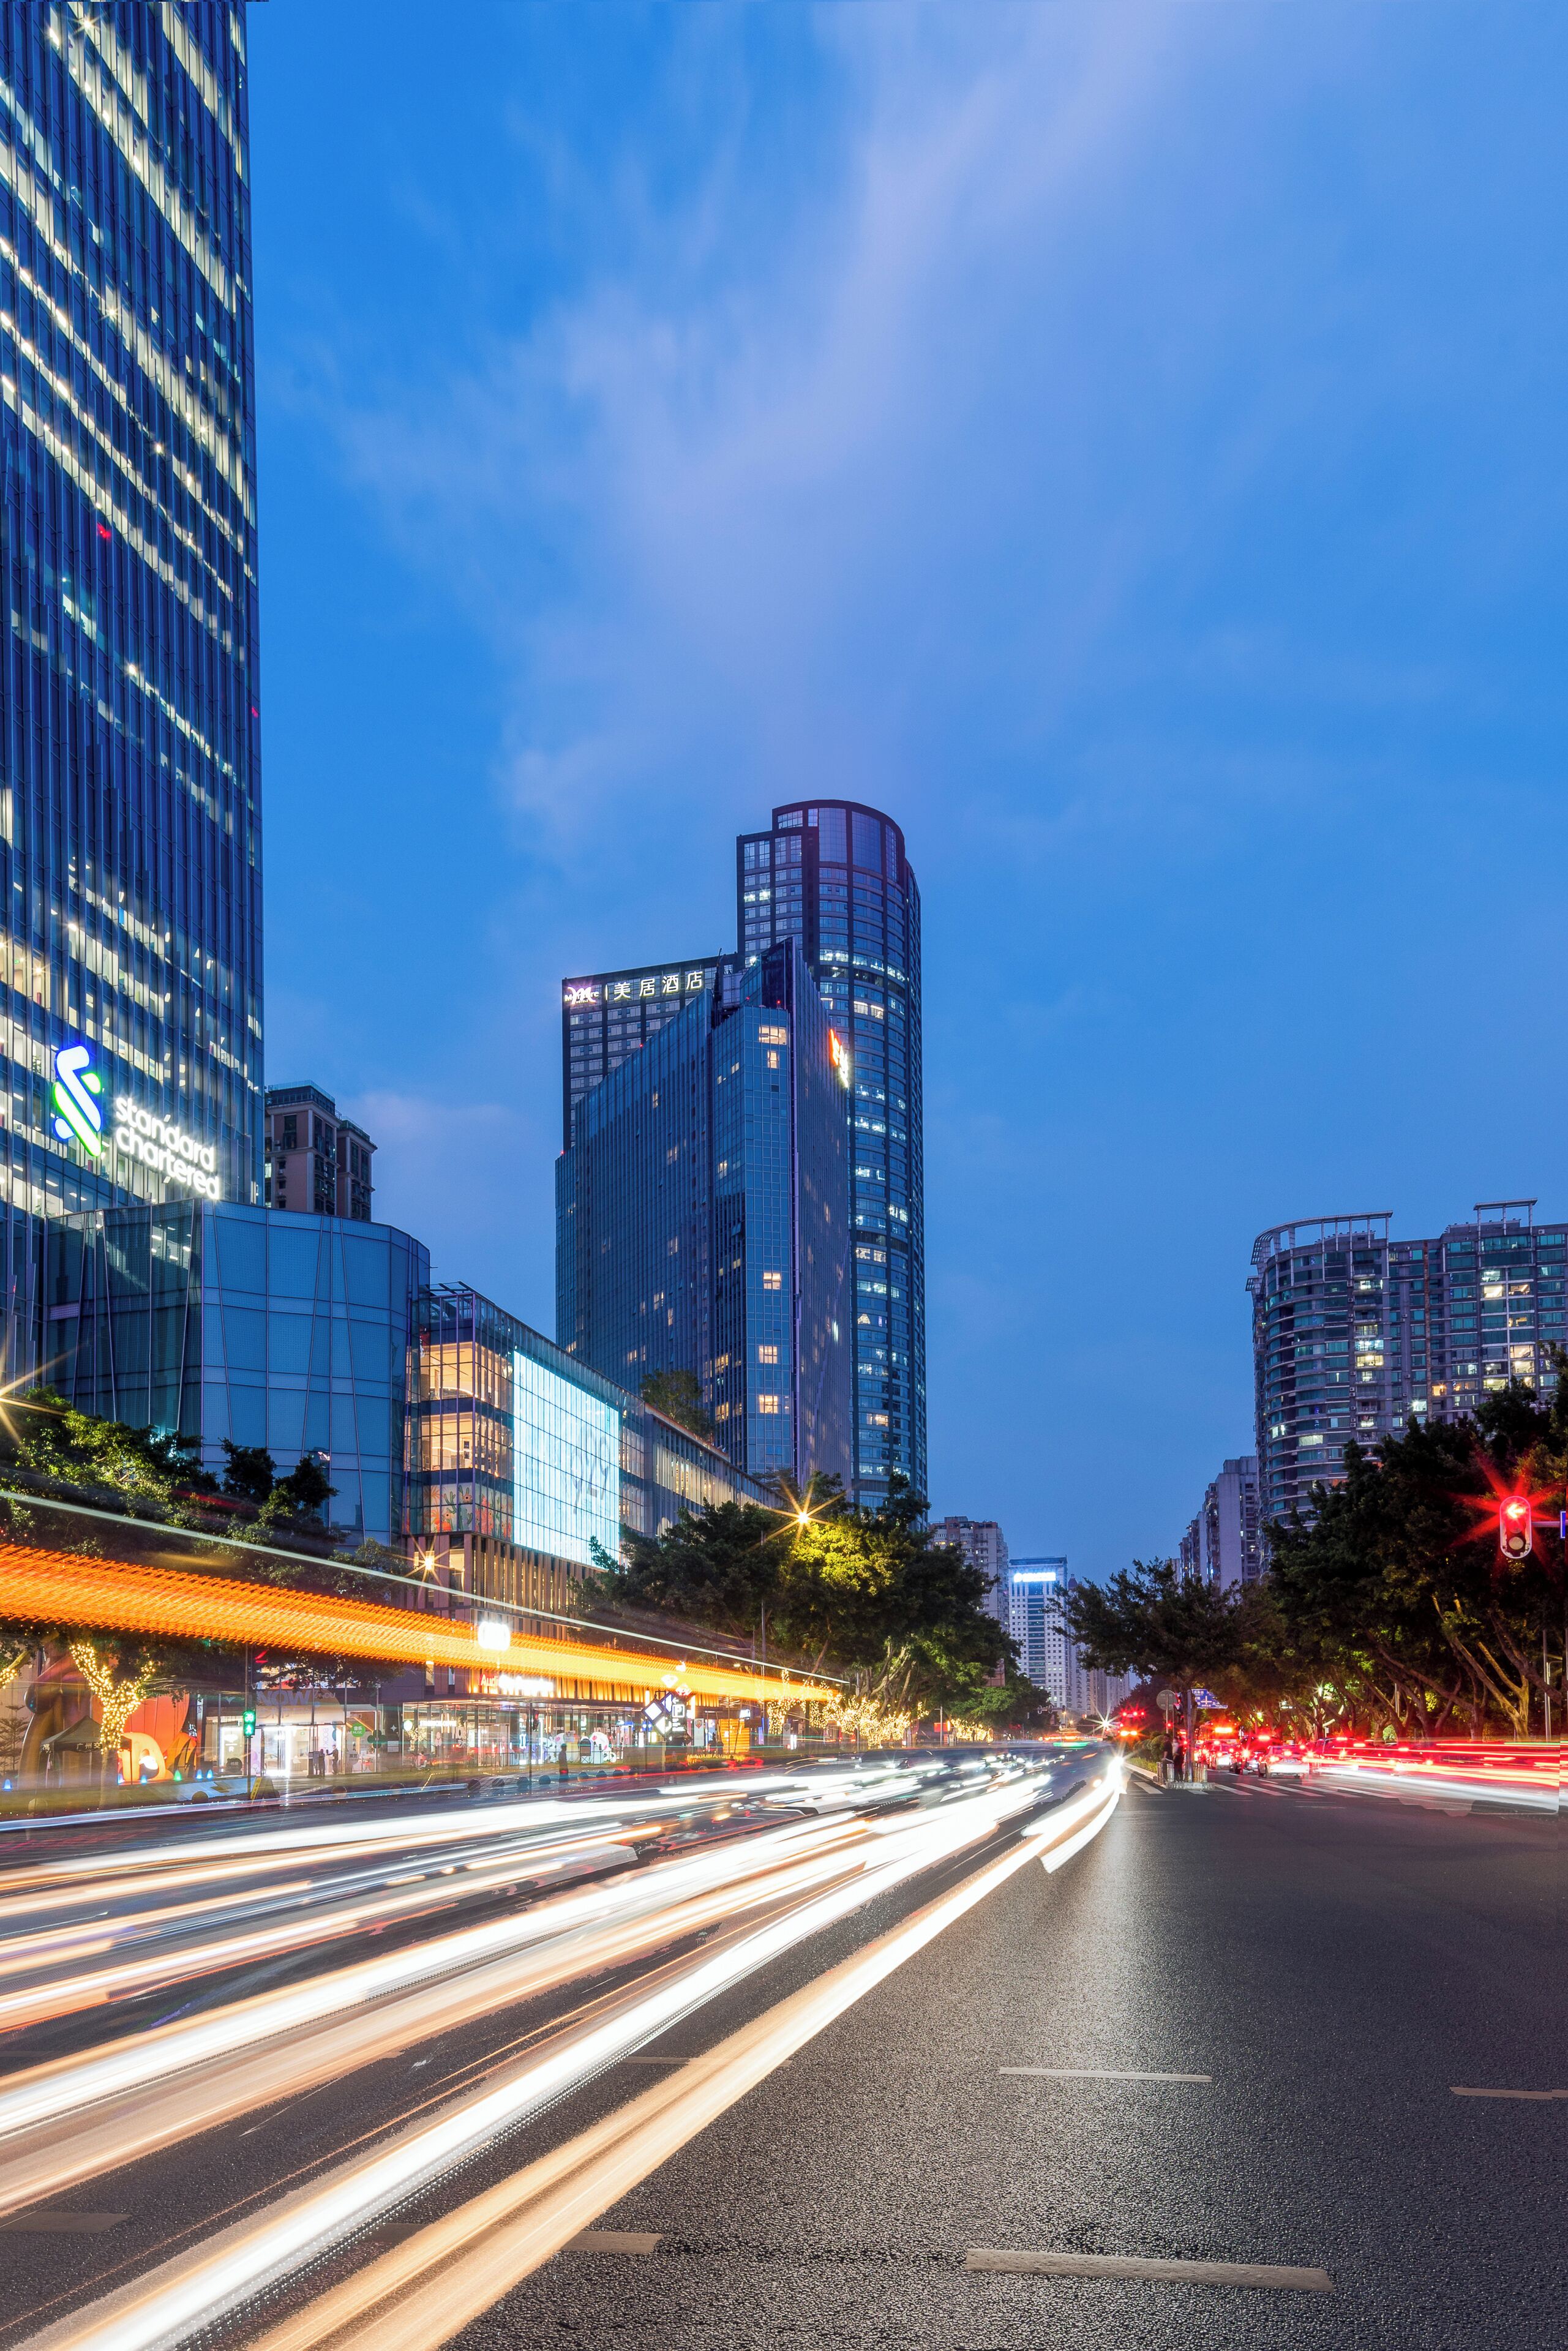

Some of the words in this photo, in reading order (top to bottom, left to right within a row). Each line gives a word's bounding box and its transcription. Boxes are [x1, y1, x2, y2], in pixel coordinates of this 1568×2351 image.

[613, 970, 703, 1000] 美居酒店
[116, 1097, 214, 1172] standard
[116, 1127, 220, 1200] chartered
